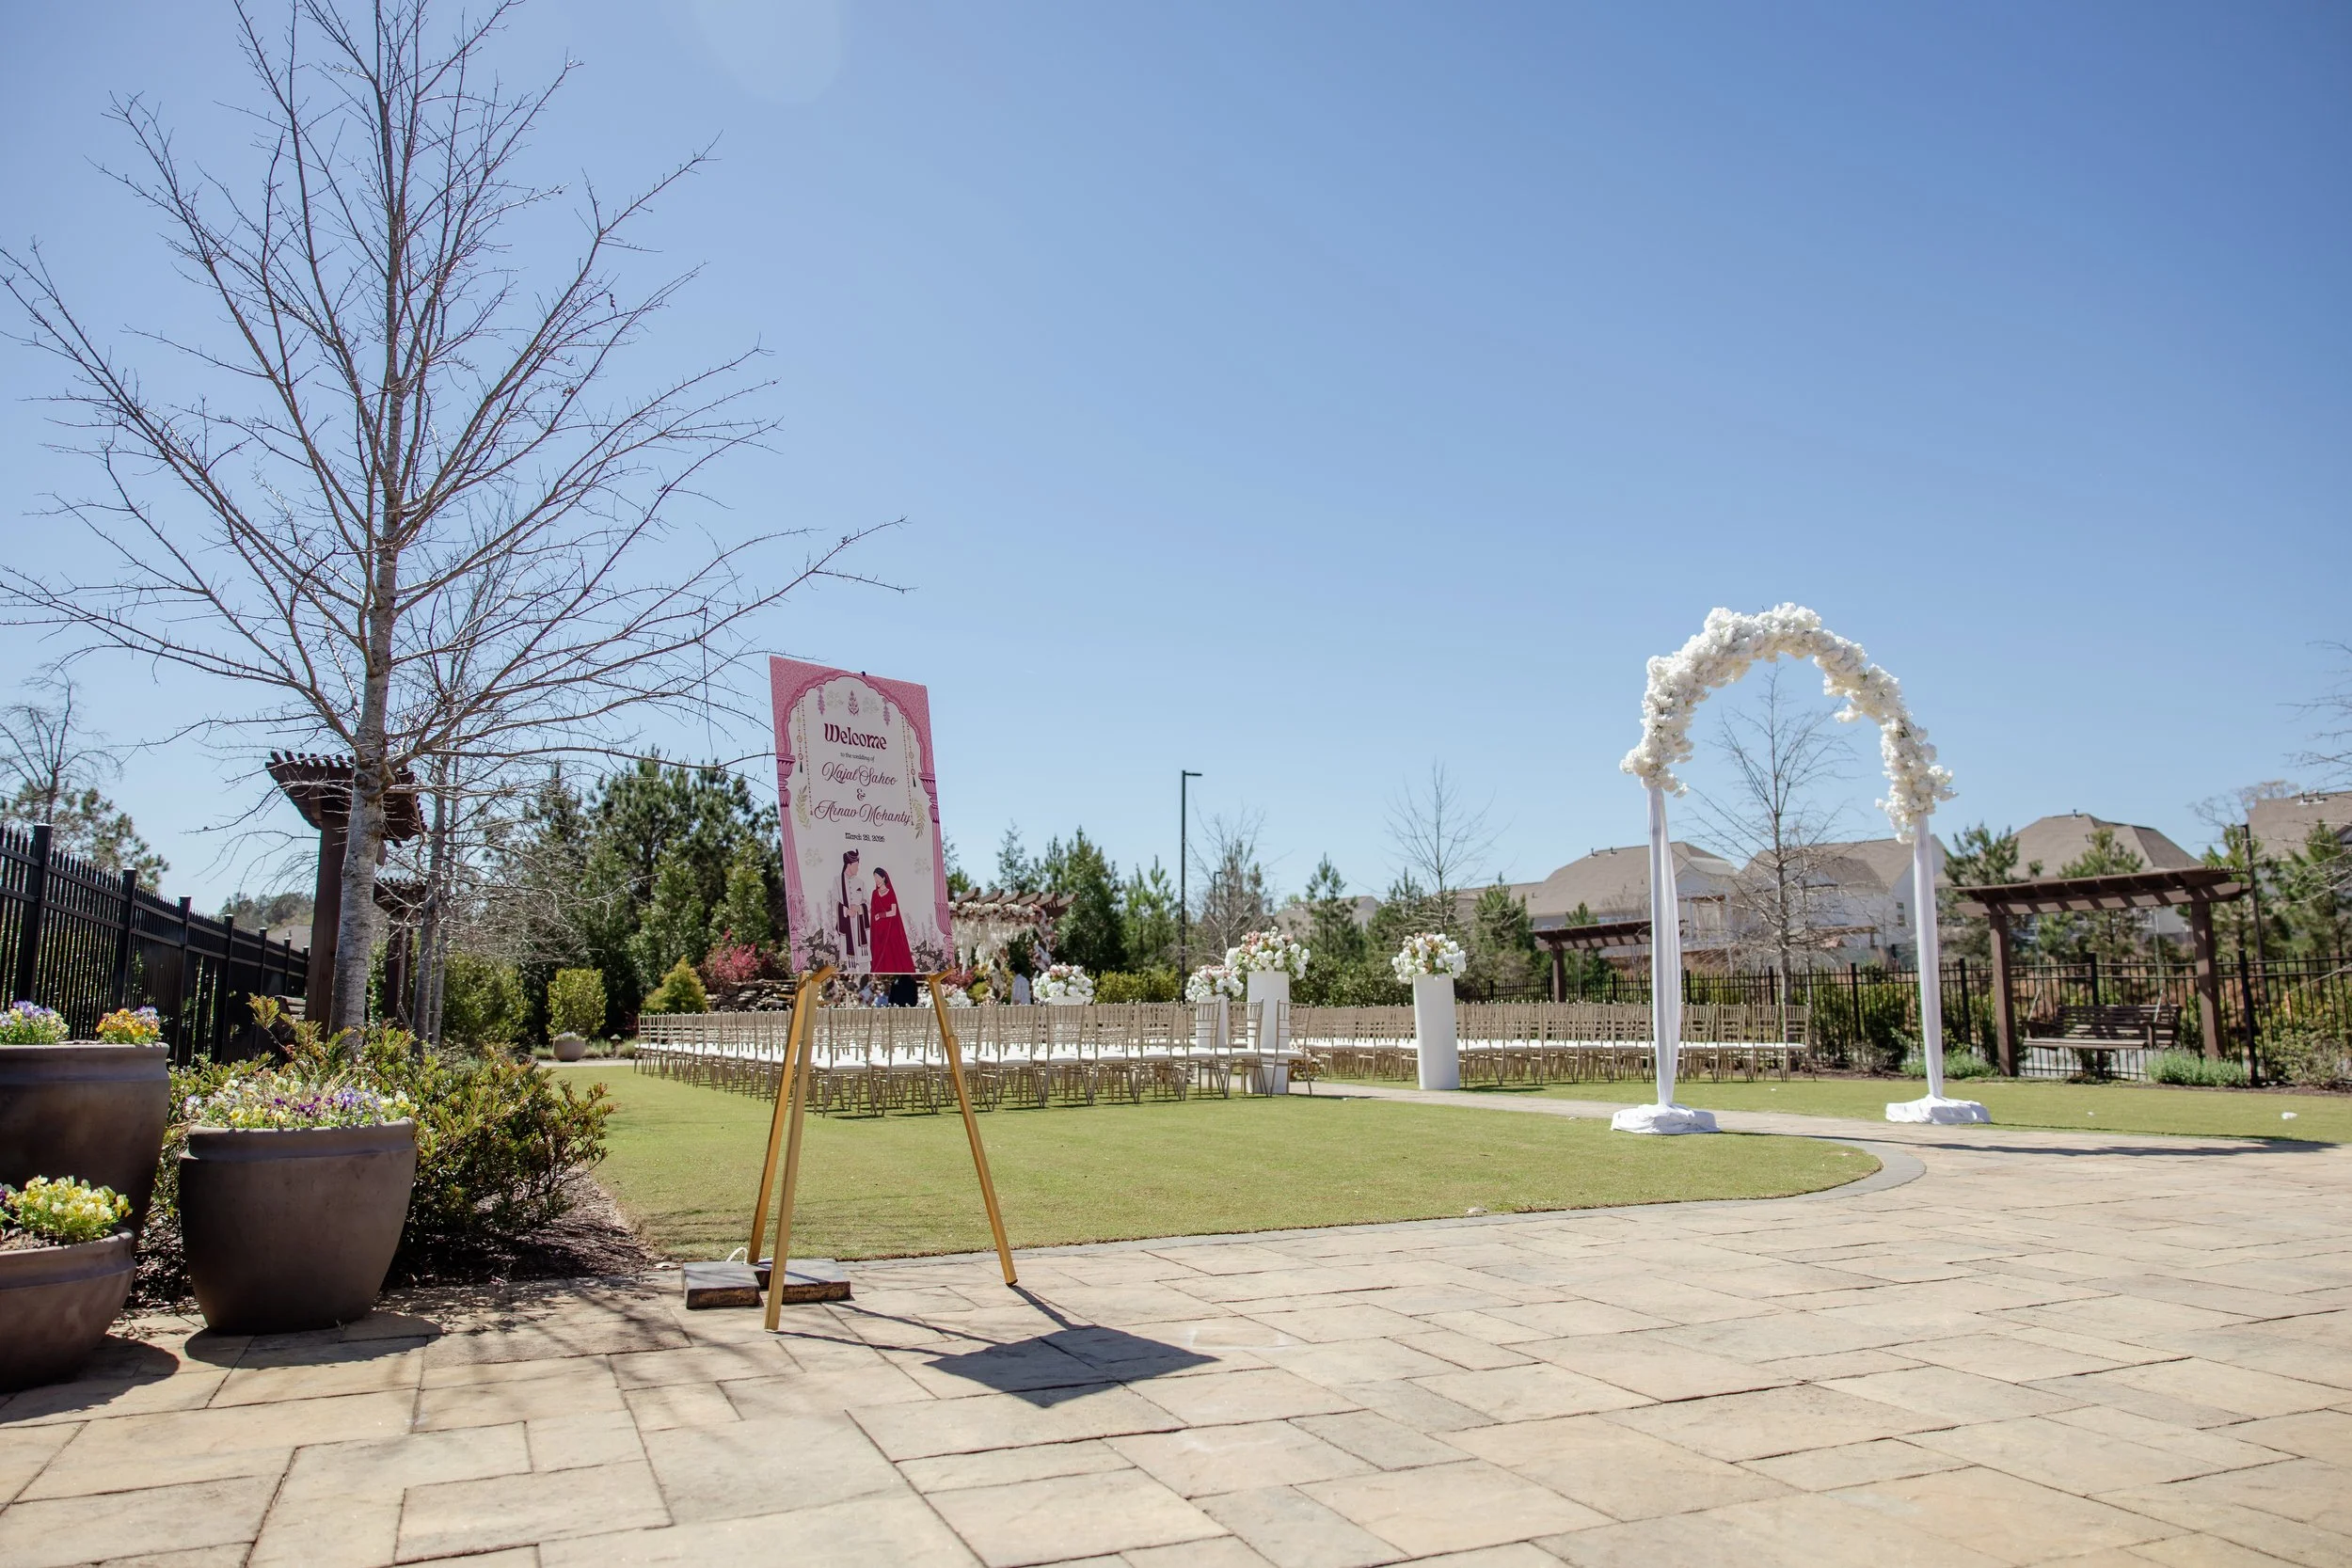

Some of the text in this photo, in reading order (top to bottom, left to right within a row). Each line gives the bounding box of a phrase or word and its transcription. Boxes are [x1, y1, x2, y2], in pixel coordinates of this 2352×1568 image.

[824, 722, 887, 750] Welcome
[822, 761, 898, 786] Kajal Sahoo
[856, 788, 866, 800] &
[814, 800, 911, 827] Arnav Mohanty
